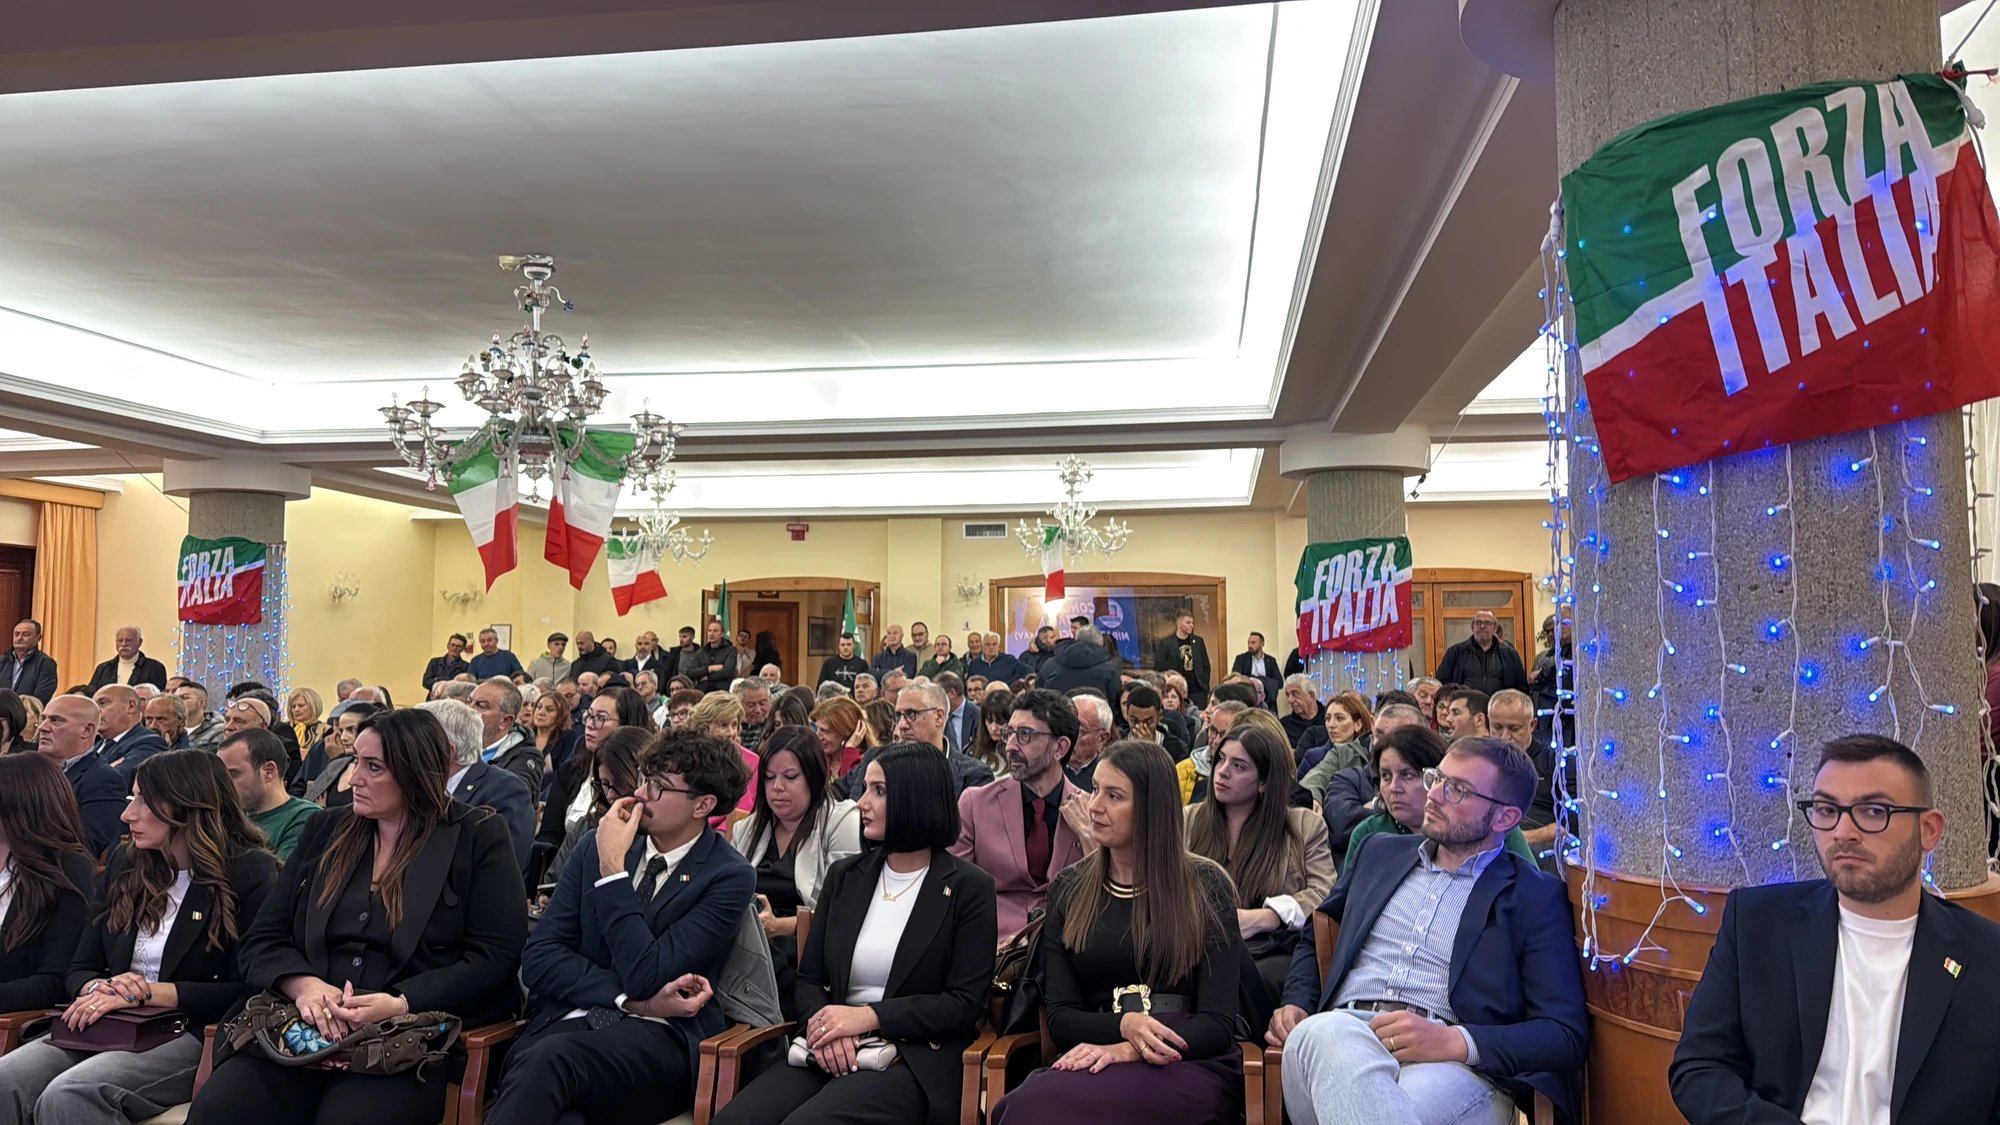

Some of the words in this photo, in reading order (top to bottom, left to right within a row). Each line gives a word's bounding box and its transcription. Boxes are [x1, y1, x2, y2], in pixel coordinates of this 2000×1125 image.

[1671, 79, 1936, 279] FORZA
[1700, 175, 1941, 397] ITALIA
[181, 546, 235, 585] FORZA
[1312, 542, 1397, 601] FORZA
[1309, 582, 1399, 644] ITALIA
